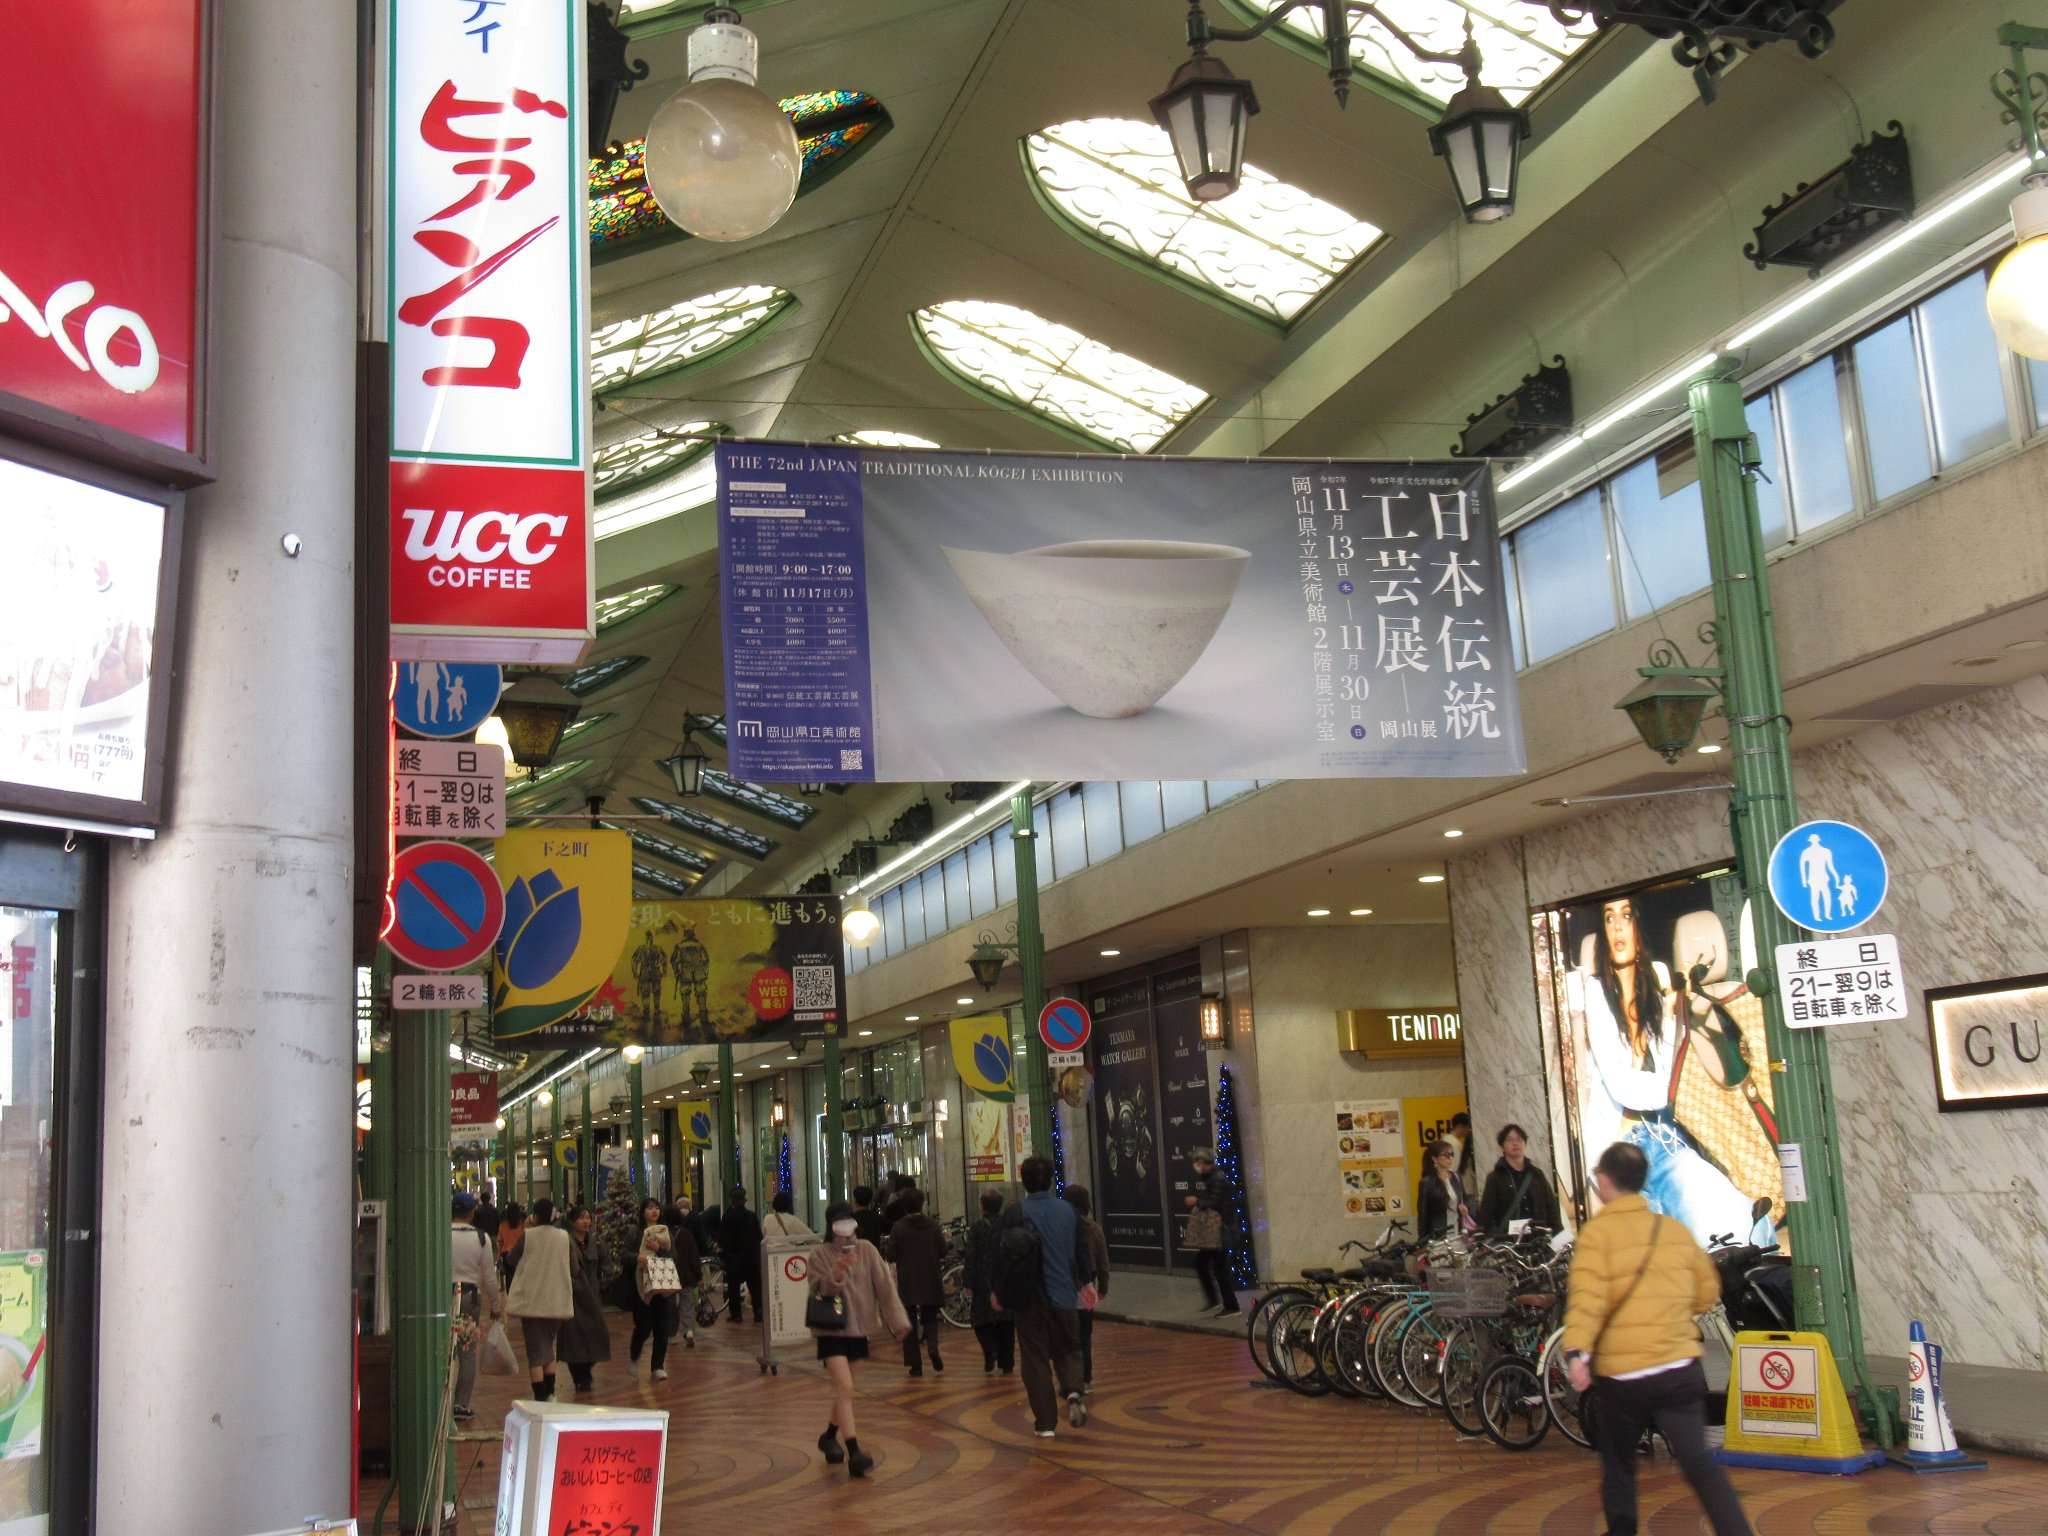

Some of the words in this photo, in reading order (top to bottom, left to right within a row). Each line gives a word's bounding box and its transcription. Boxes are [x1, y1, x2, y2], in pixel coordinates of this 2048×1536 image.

[398, 79, 569, 390] ビアンコ
[727, 456, 762, 470] THE
[767, 457, 804, 471] 72nd
[808, 459, 857, 473] JAPAN
[862, 461, 975, 478] TRADITIONAL
[1032, 468, 1124, 483] EXHIBITION
[427, 565, 532, 590] COFFEE
[1428, 489, 1501, 740] 日本伝統
[766, 726, 861, 739] 岡山県立美術館
[1380, 720, 1438, 739] 岡山展
[540, 840, 589, 859] 下之町
[401, 984, 477, 1001] 2輪を除く
[758, 986, 787, 998] WEB
[1792, 993, 1898, 1021] 自転車を除く
[1963, 1018, 2042, 1068] GU
[581, 1446, 638, 1464] スパゲティと
